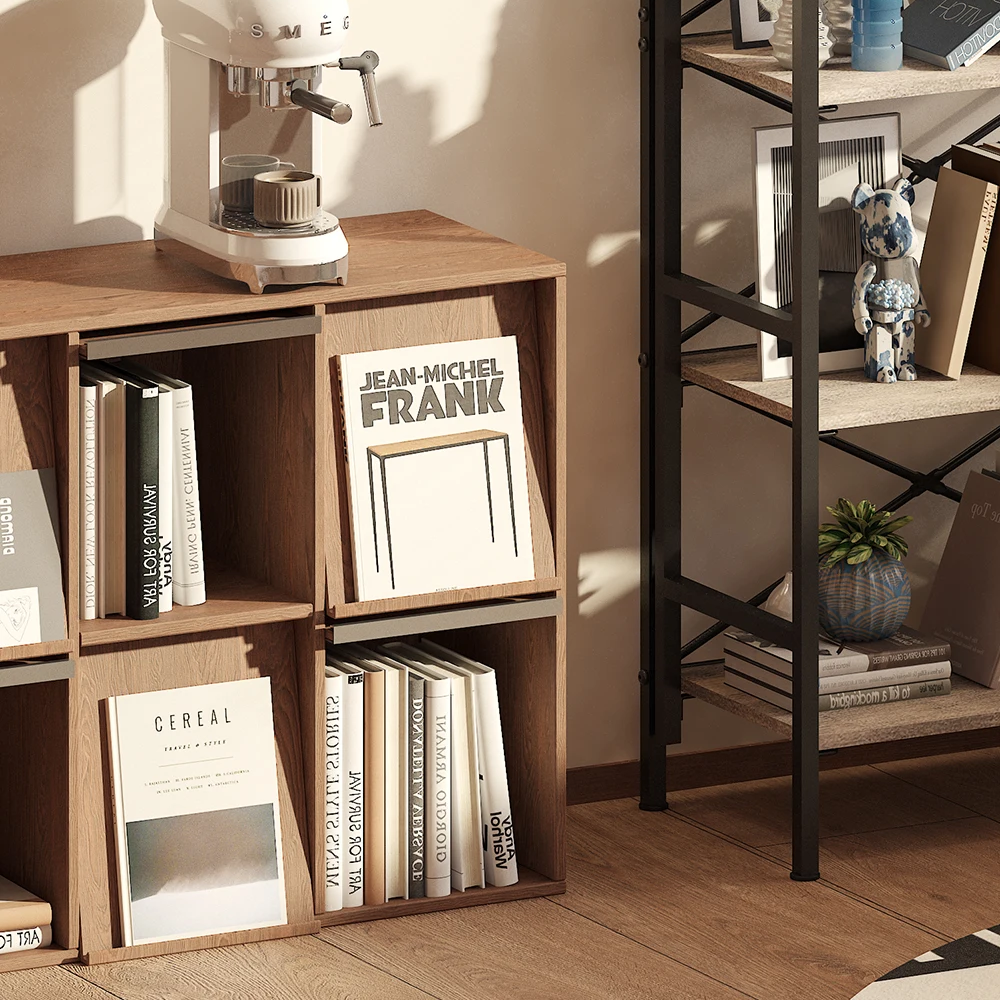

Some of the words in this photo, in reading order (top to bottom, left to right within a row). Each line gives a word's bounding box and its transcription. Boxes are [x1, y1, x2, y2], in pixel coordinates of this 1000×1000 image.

[359, 358, 504, 392] JEAN-MICHEL
[360, 377, 506, 428] FRANK
[154, 707, 232, 733] CEREAL
[164, 744, 191, 752] TRAVEL
[204, 739, 227, 747] STYLE
